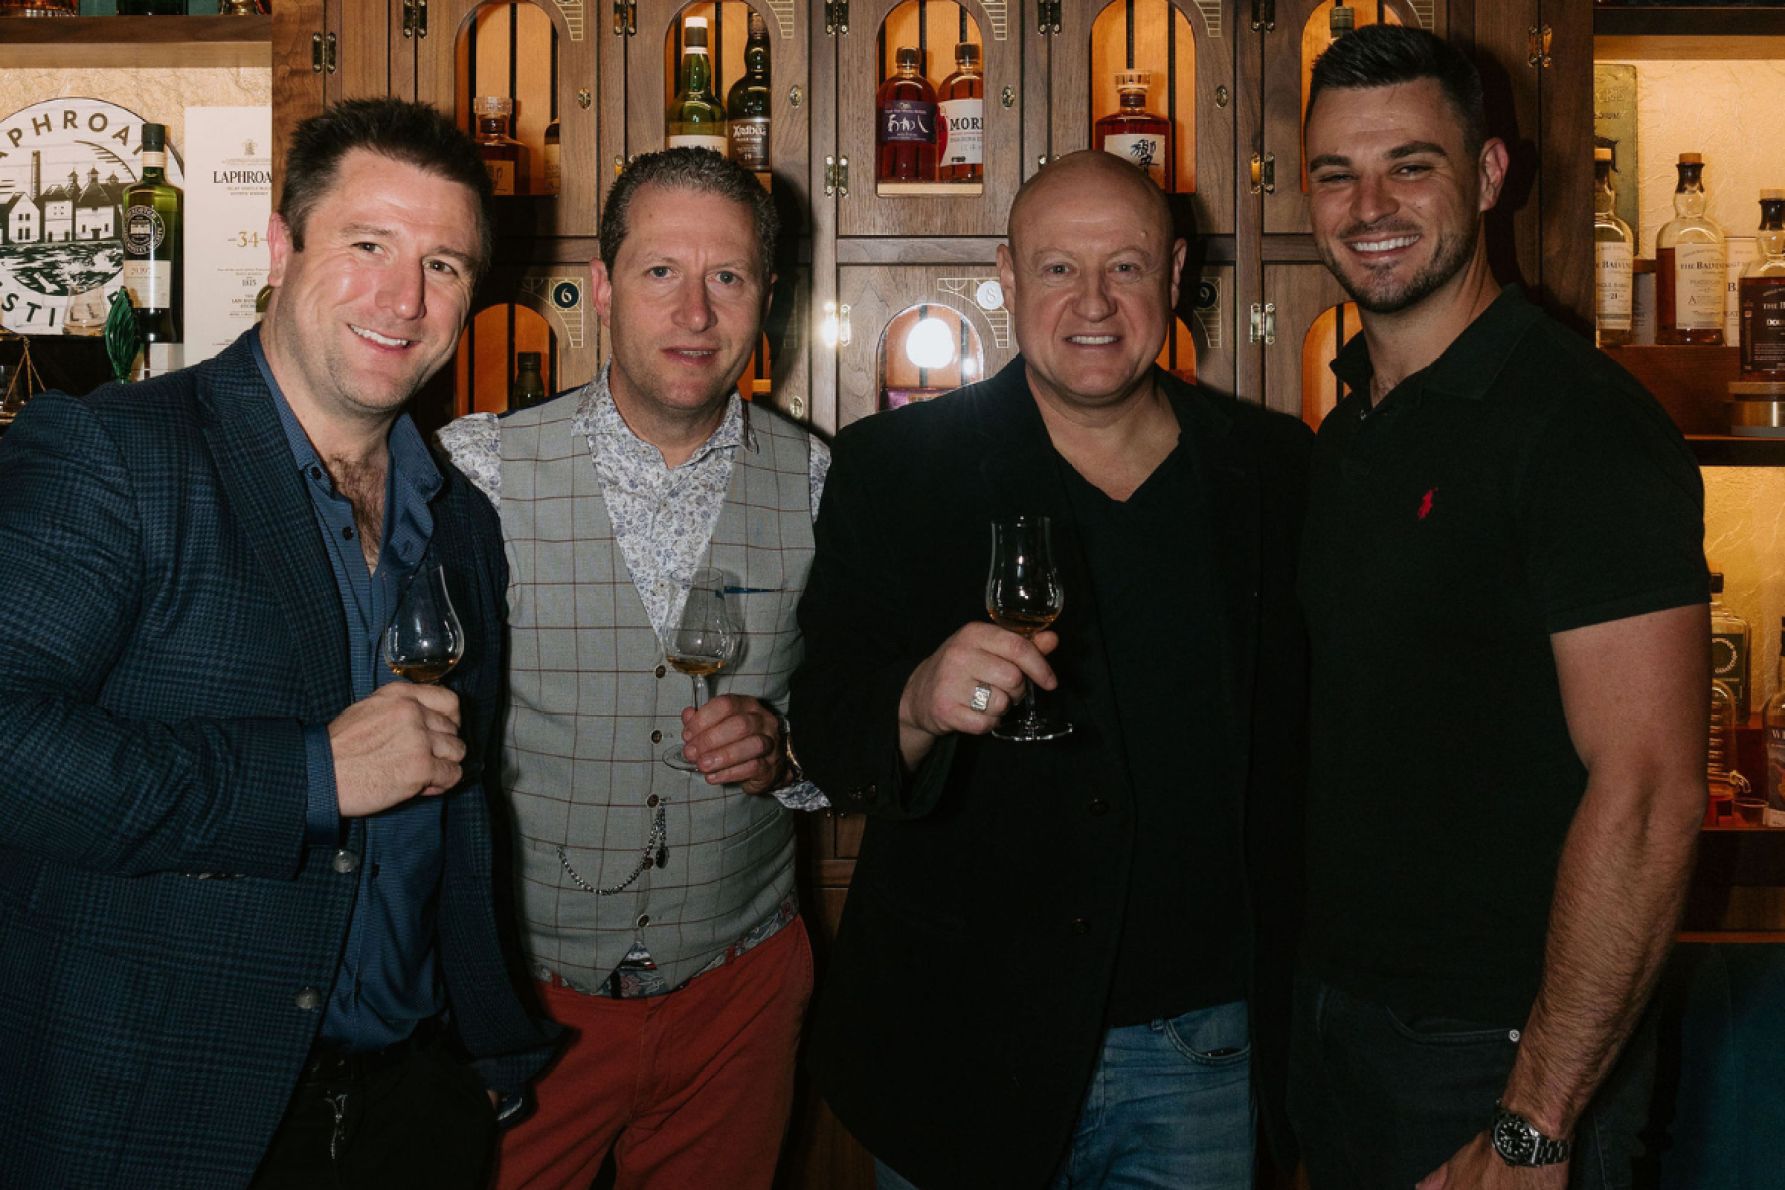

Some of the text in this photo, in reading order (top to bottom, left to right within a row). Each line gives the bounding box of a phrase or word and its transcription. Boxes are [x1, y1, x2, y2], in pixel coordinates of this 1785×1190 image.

[950, 116, 984, 131] MOR
[213, 170, 272, 184] LAPHROA
[237, 231, 259, 248] 34
[561, 287, 572, 303] 6
[0, 281, 121, 327] STILL
